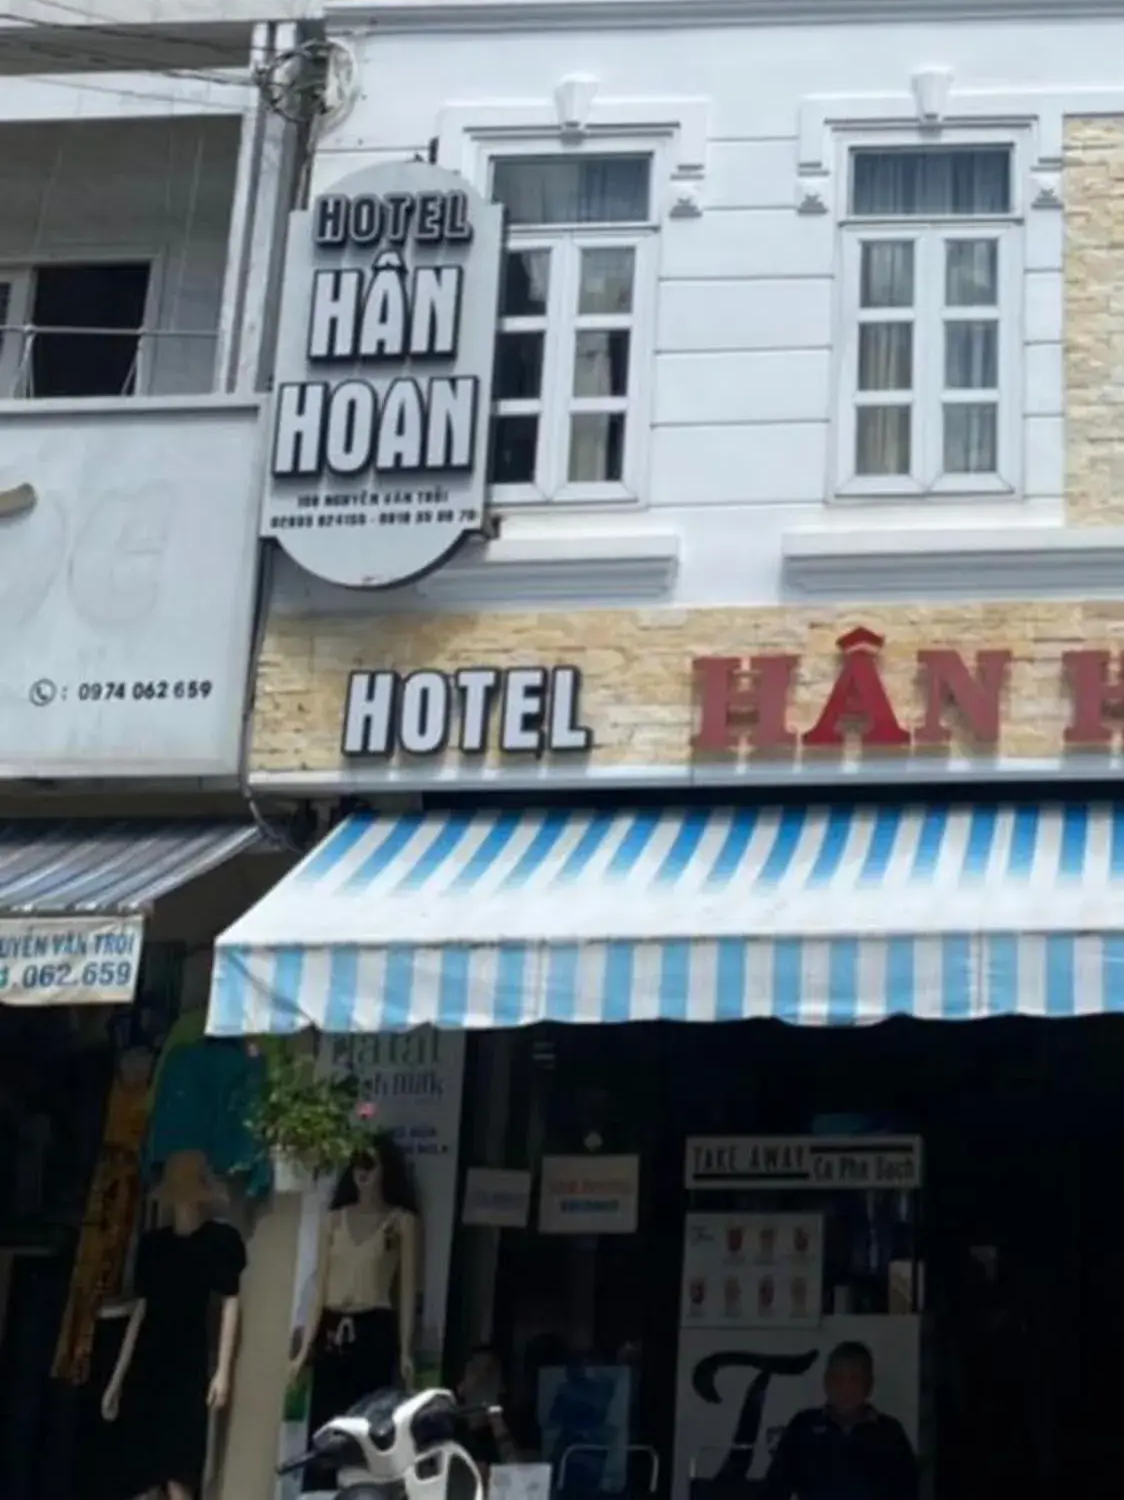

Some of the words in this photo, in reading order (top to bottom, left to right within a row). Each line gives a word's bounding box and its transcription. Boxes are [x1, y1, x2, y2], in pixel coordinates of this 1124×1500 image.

[313, 190, 473, 246] HOTEL
[309, 250, 463, 359] HÂN
[272, 375, 480, 479] HOAN
[78, 682, 126, 701] 0974
[131, 680, 169, 700] 062
[173, 680, 213, 699] 659
[342, 665, 595, 758] HOTEL
[689, 626, 1013, 746] HÂN
